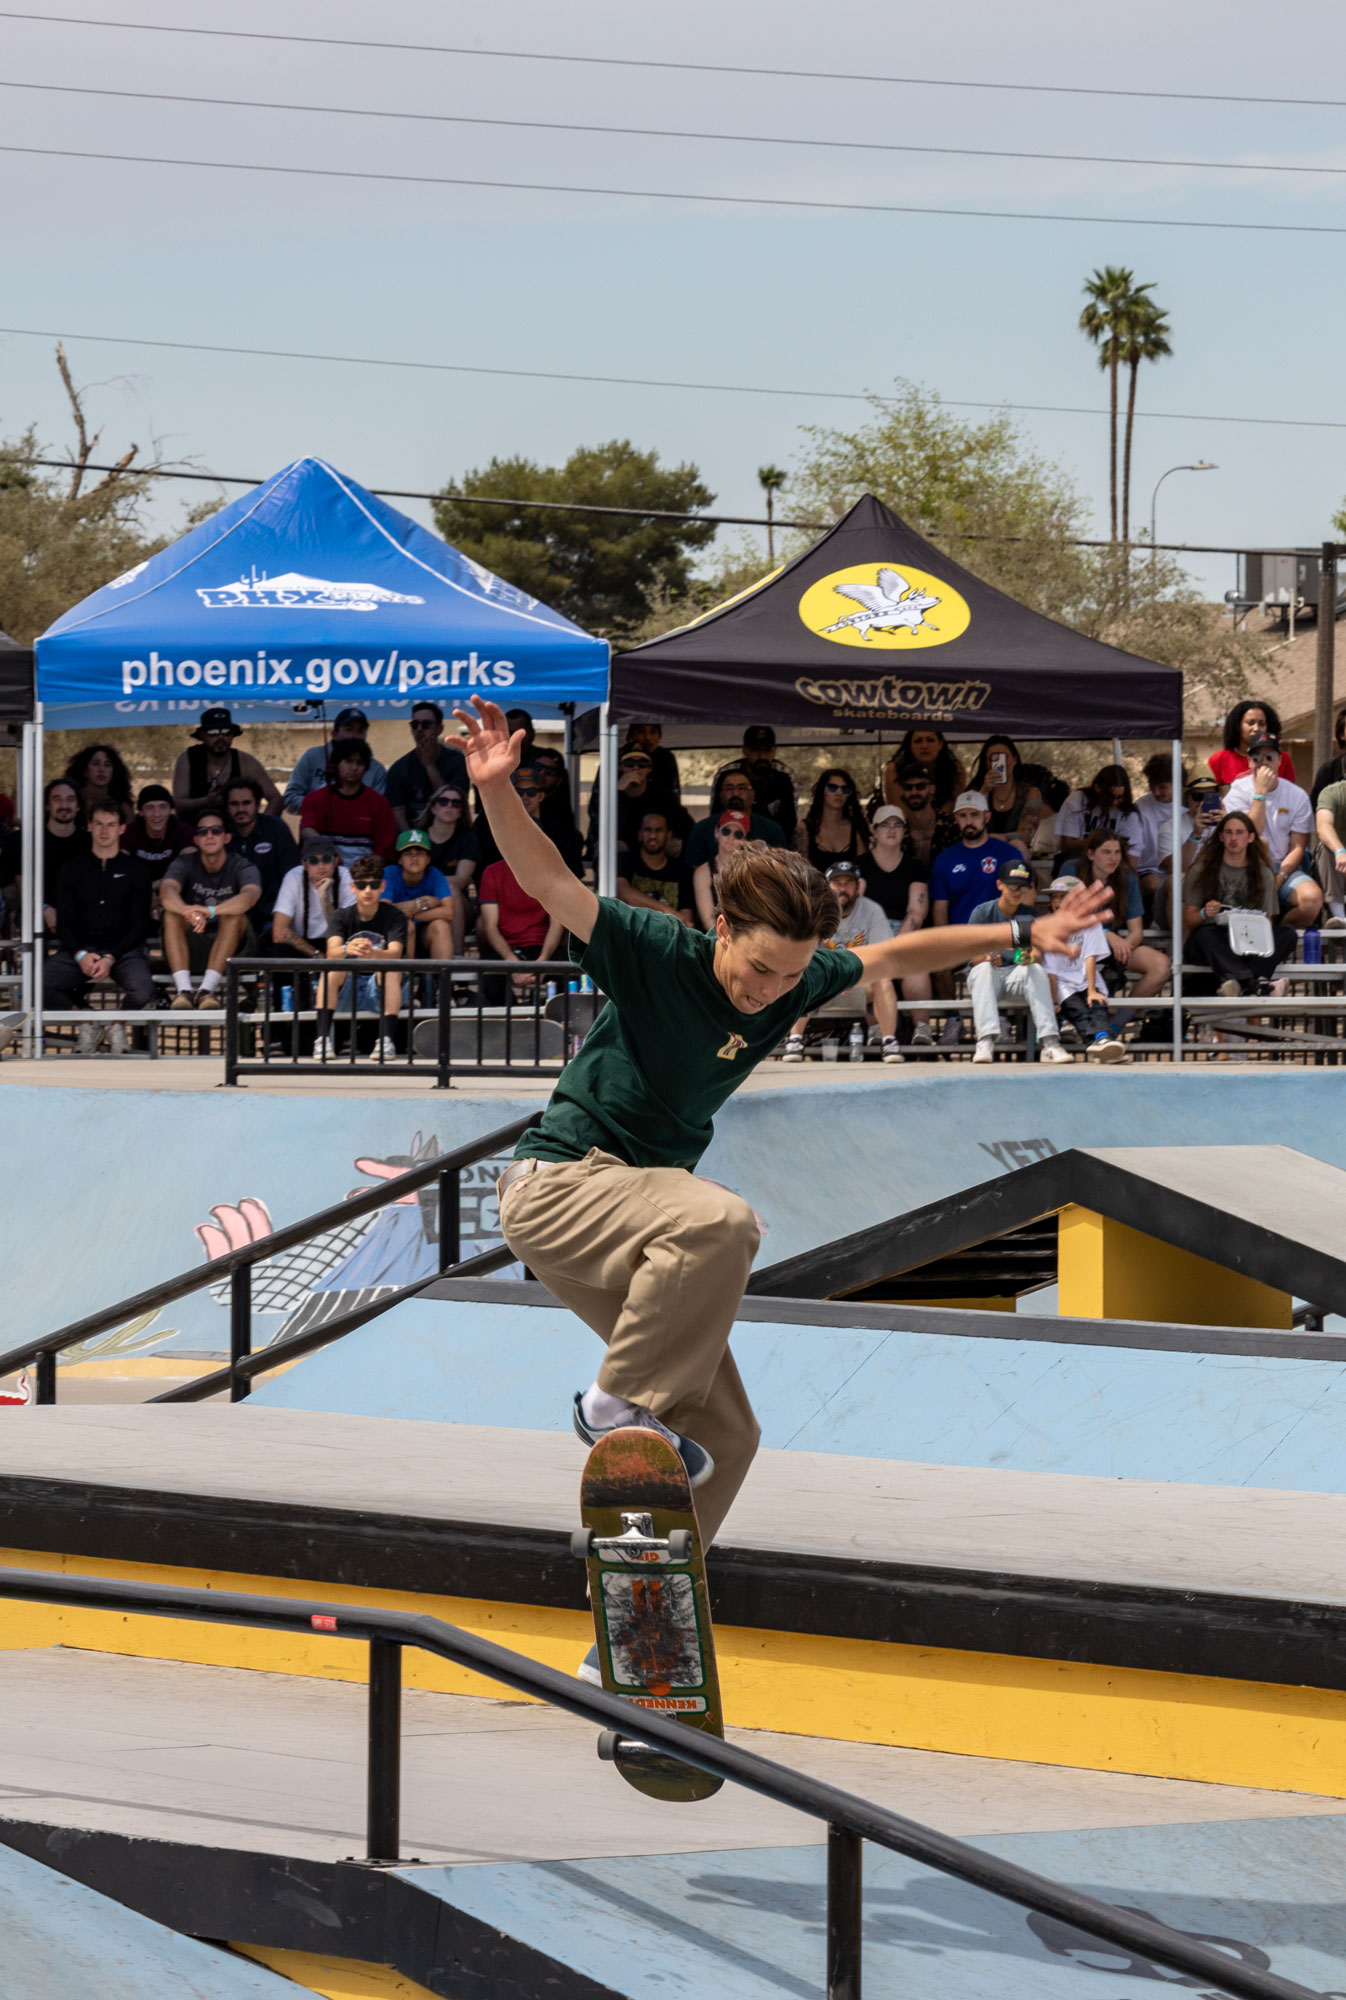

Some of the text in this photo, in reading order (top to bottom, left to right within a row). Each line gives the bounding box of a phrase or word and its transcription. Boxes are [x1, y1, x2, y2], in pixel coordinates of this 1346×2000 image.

[121, 650, 517, 695] phoenix.gov/parks
[832, 708, 954, 722] skateboards
[977, 1137, 1059, 1171] YETI
[627, 1697, 697, 1710] KENNED
